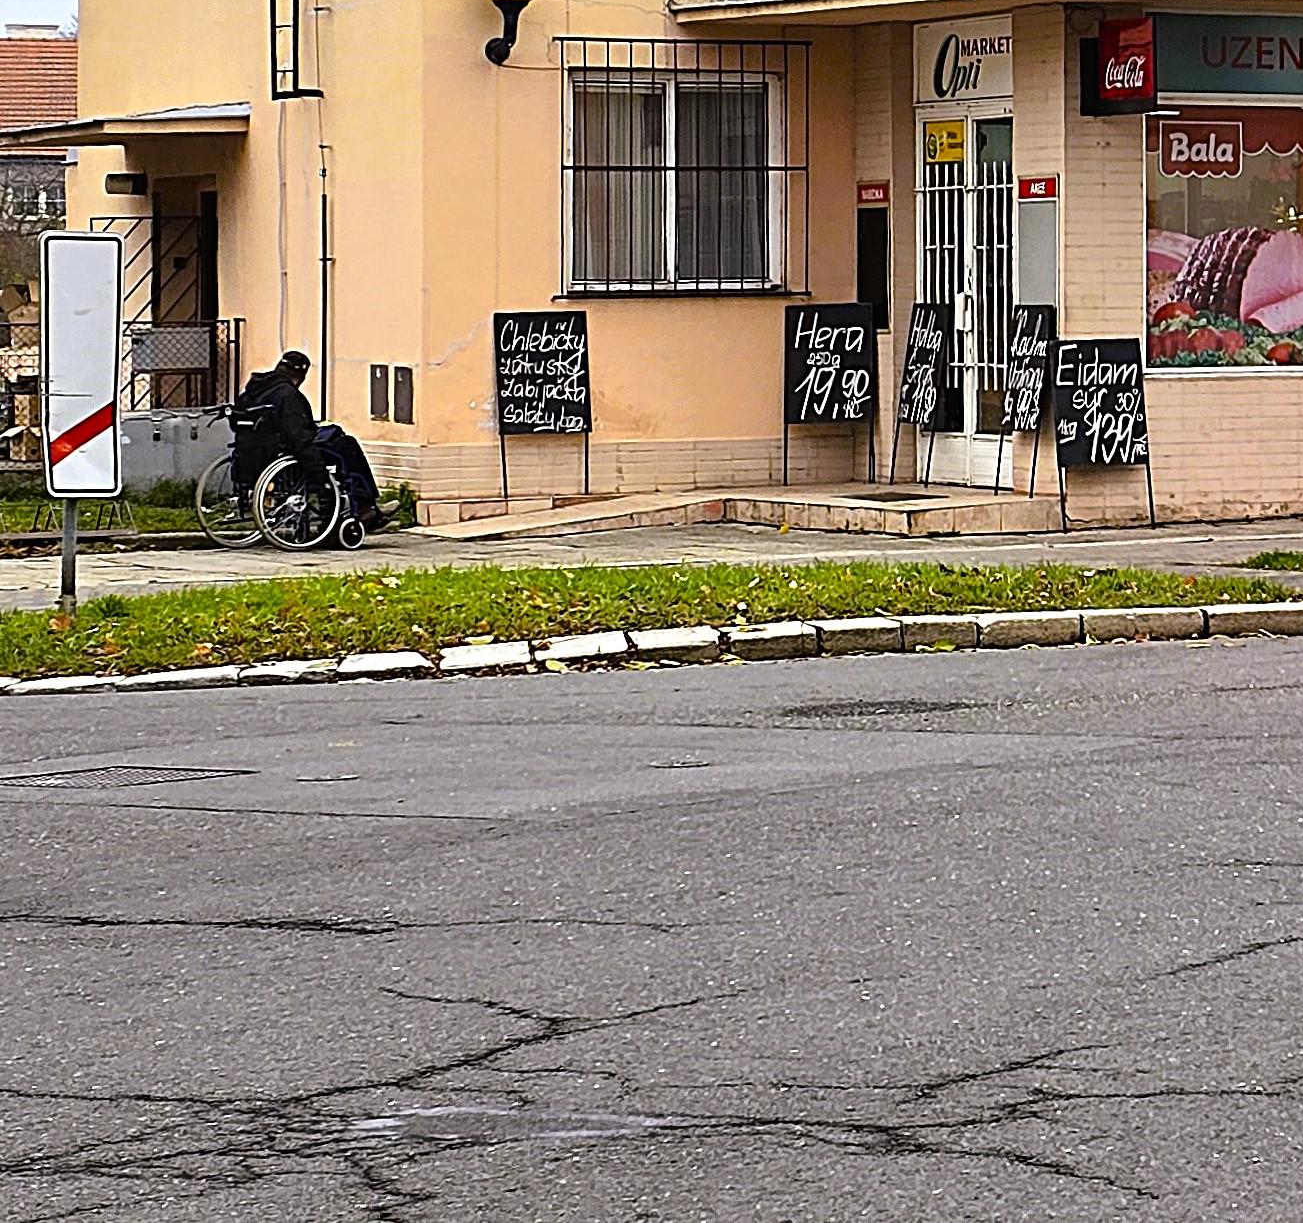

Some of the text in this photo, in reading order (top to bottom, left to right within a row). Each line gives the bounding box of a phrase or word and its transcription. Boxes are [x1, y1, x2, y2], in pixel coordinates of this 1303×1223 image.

[933, 34, 982, 99] Opti
[960, 36, 1013, 58] MARKET
[1168, 131, 1235, 163] Bala
[794, 312, 865, 353] Hera
[1056, 344, 1139, 387] Eidam
